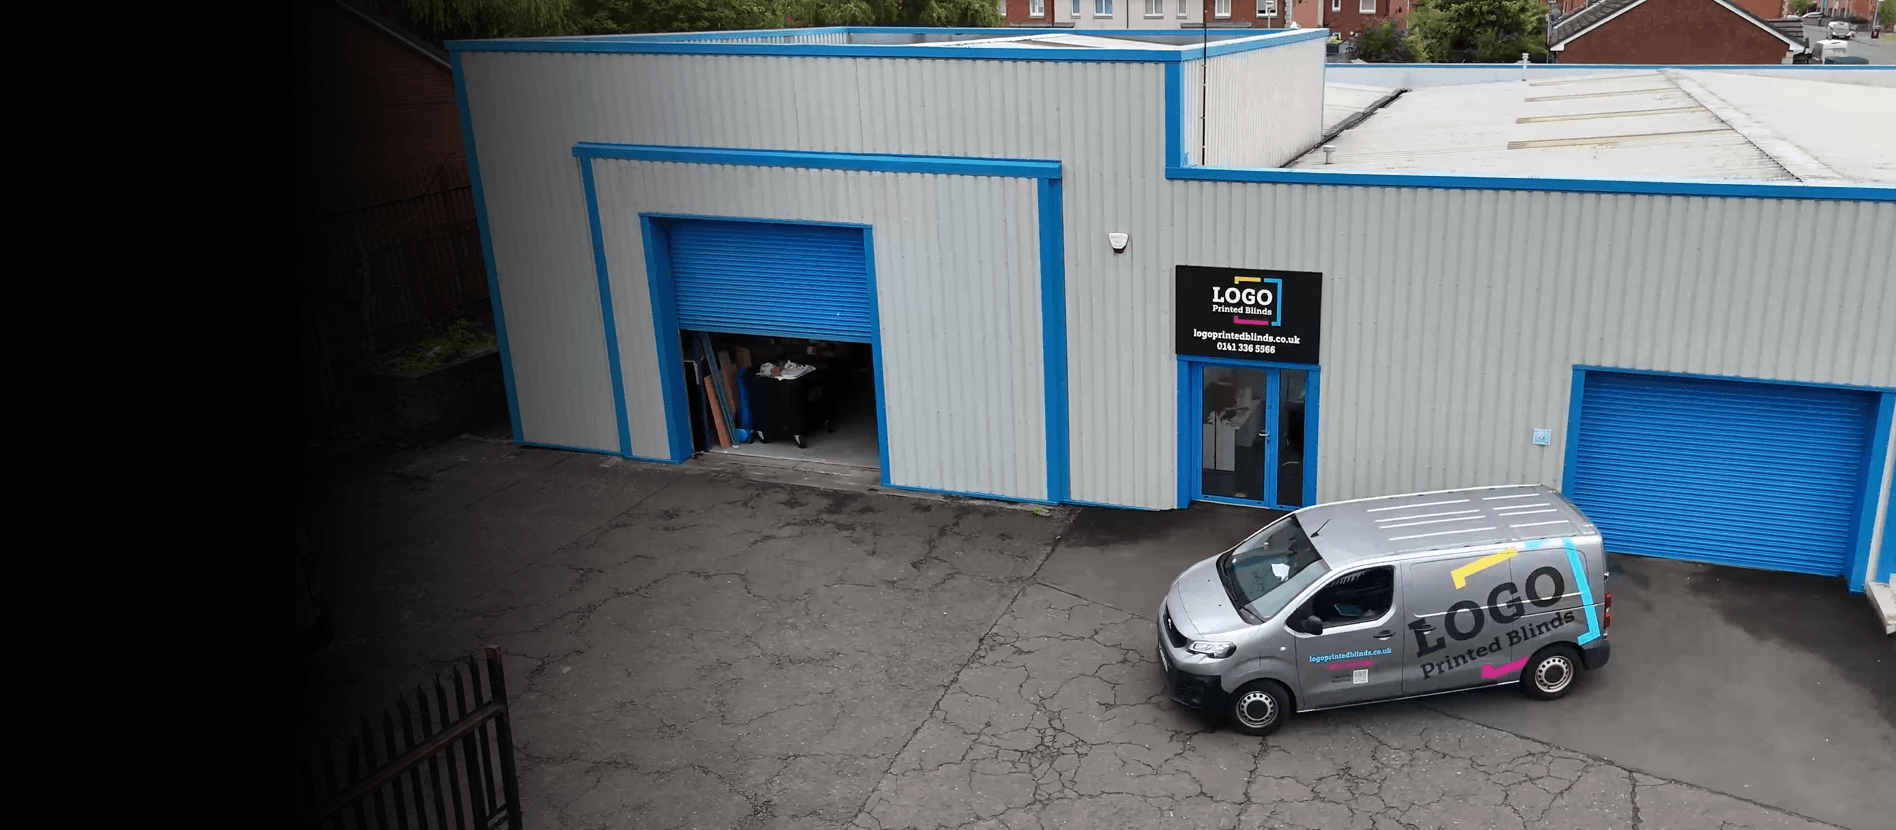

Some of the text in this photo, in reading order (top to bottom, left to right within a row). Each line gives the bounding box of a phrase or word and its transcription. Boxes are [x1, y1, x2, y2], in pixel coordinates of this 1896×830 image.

[1212, 286, 1273, 305] LOGO
[1212, 305, 1272, 315] Printed Blinds
[1193, 329, 1300, 344] logoprintedblinds.co.uk
[1217, 342, 1275, 353] 0141 336 5566
[1408, 566, 1565, 658] LOGO
[1420, 609, 1576, 680] Printed Blinds
[1309, 647, 1393, 663] logoprintedblinds.co.uk
